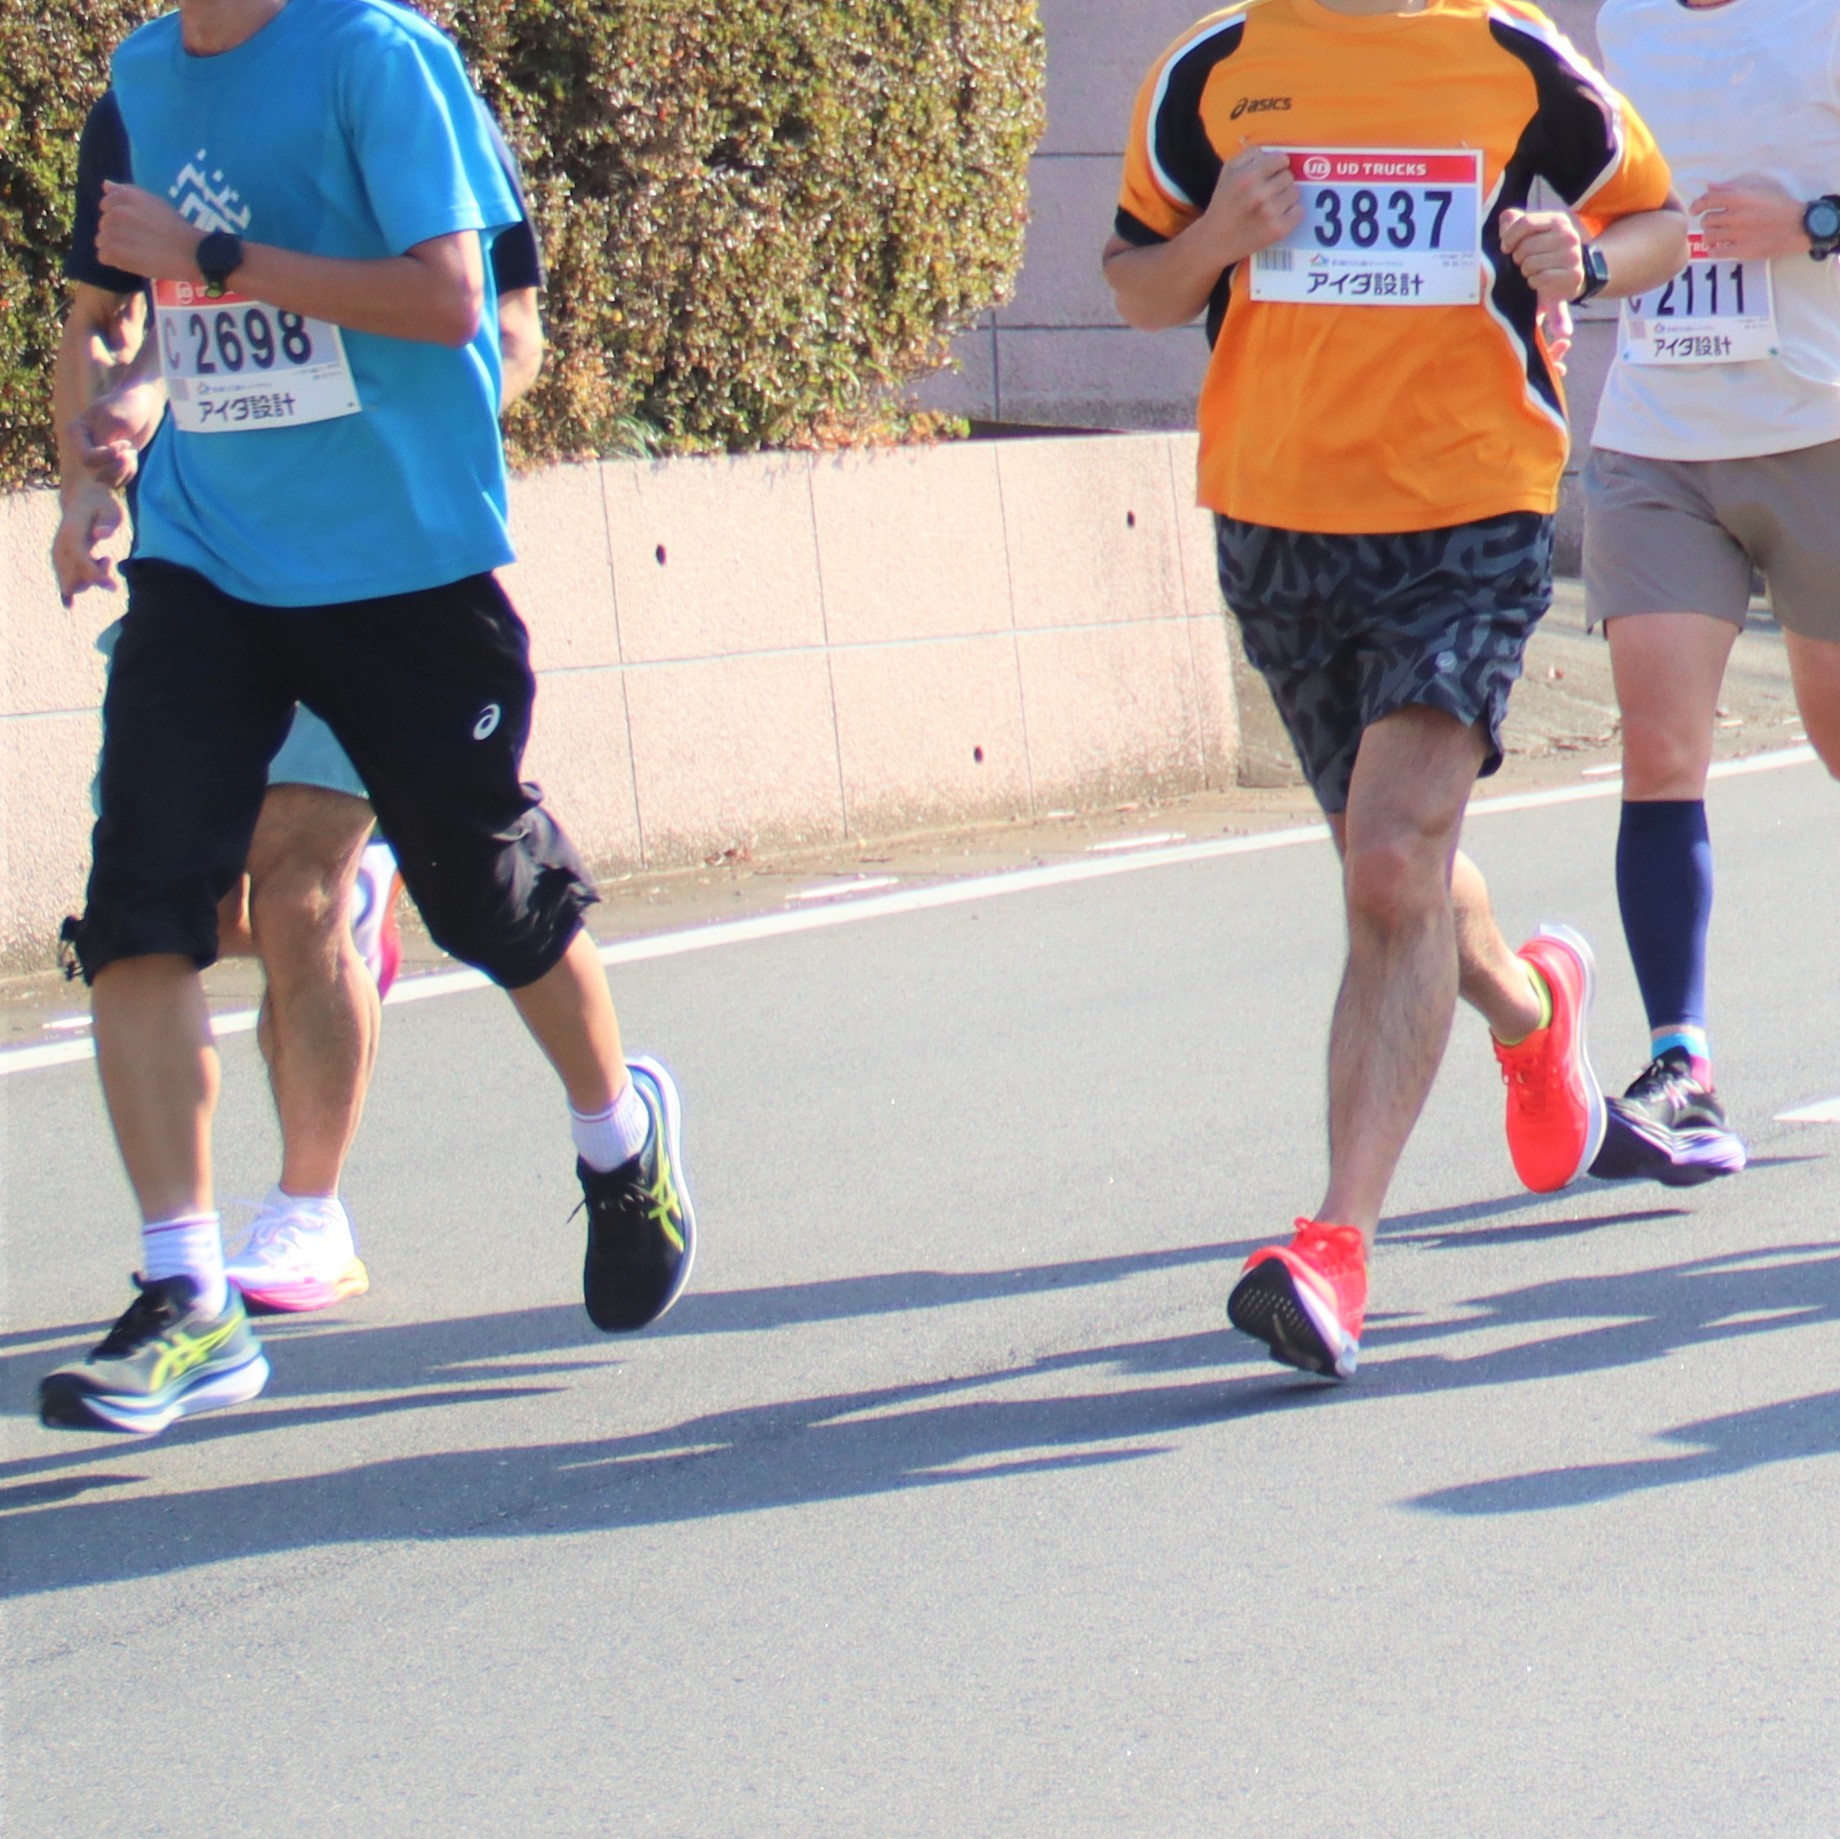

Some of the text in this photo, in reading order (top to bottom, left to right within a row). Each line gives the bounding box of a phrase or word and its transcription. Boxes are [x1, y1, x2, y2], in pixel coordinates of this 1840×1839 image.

[1336, 163, 1359, 175] UD
[1363, 163, 1427, 176] TRUCKS
[1314, 189, 1452, 249] 3837
[1307, 272, 1424, 296] アイダ設計
[1656, 264, 1744, 316] 2111
[165, 309, 311, 374] C 2698
[1655, 336, 1732, 357] アイダ設計
[198, 392, 295, 423] アイダ設計
